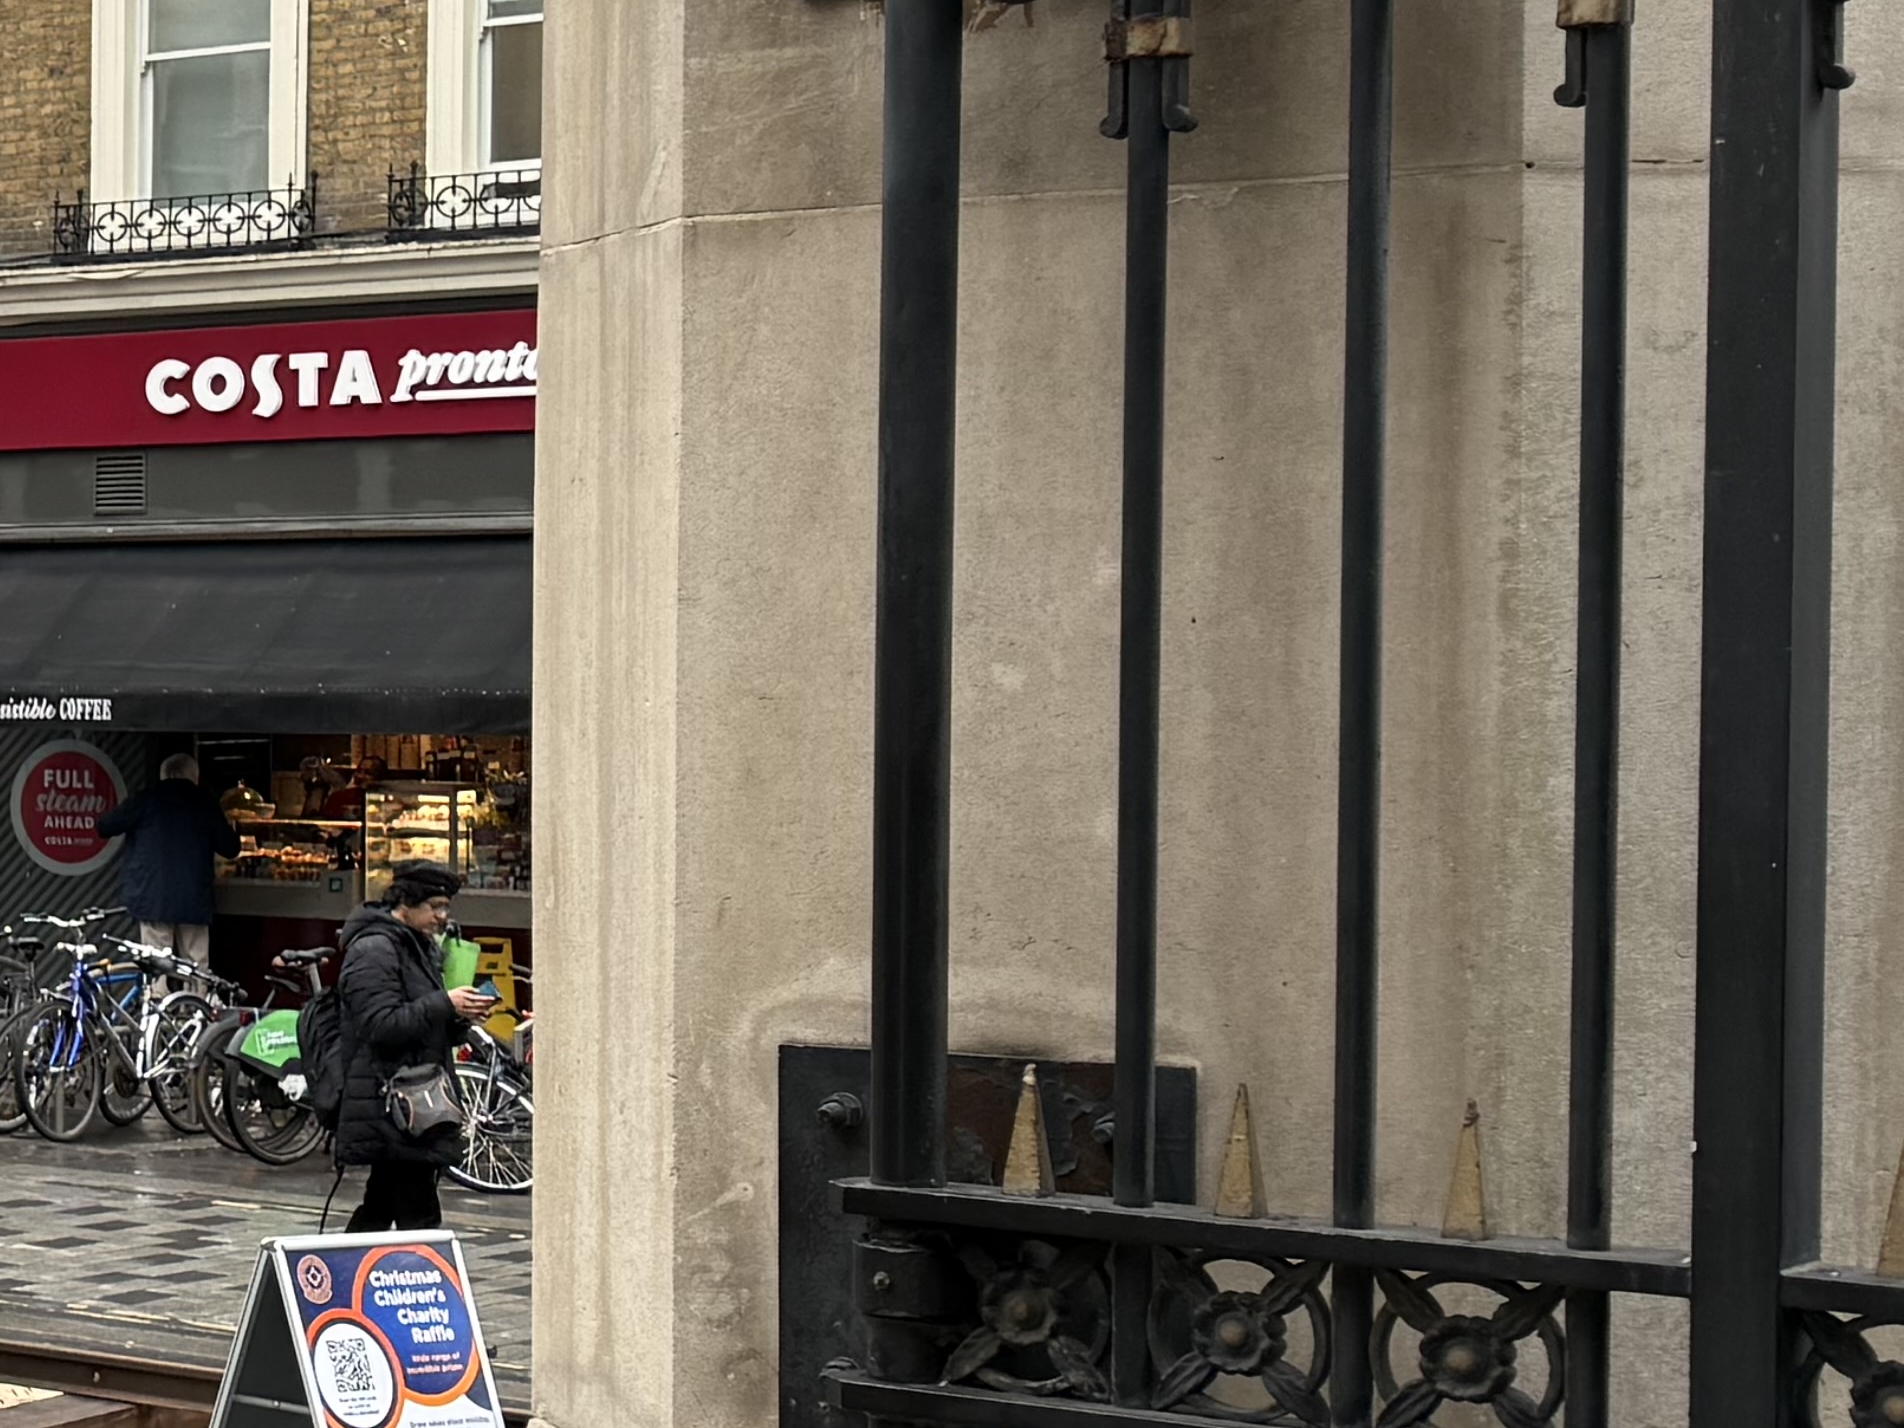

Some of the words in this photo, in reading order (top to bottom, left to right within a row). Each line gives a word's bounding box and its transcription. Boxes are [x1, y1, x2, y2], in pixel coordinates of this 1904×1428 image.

[145, 350, 383, 418] COSTA
[59, 698, 111, 721] COFFEE
[44, 769, 95, 789] FULL
[35, 788, 106, 813] steam
[44, 815, 95, 829] AHEAD
[369, 1270, 442, 1287] Christmas
[374, 1288, 446, 1306] Children's
[397, 1306, 449, 1325] Charity
[411, 1324, 455, 1343] Raffle
